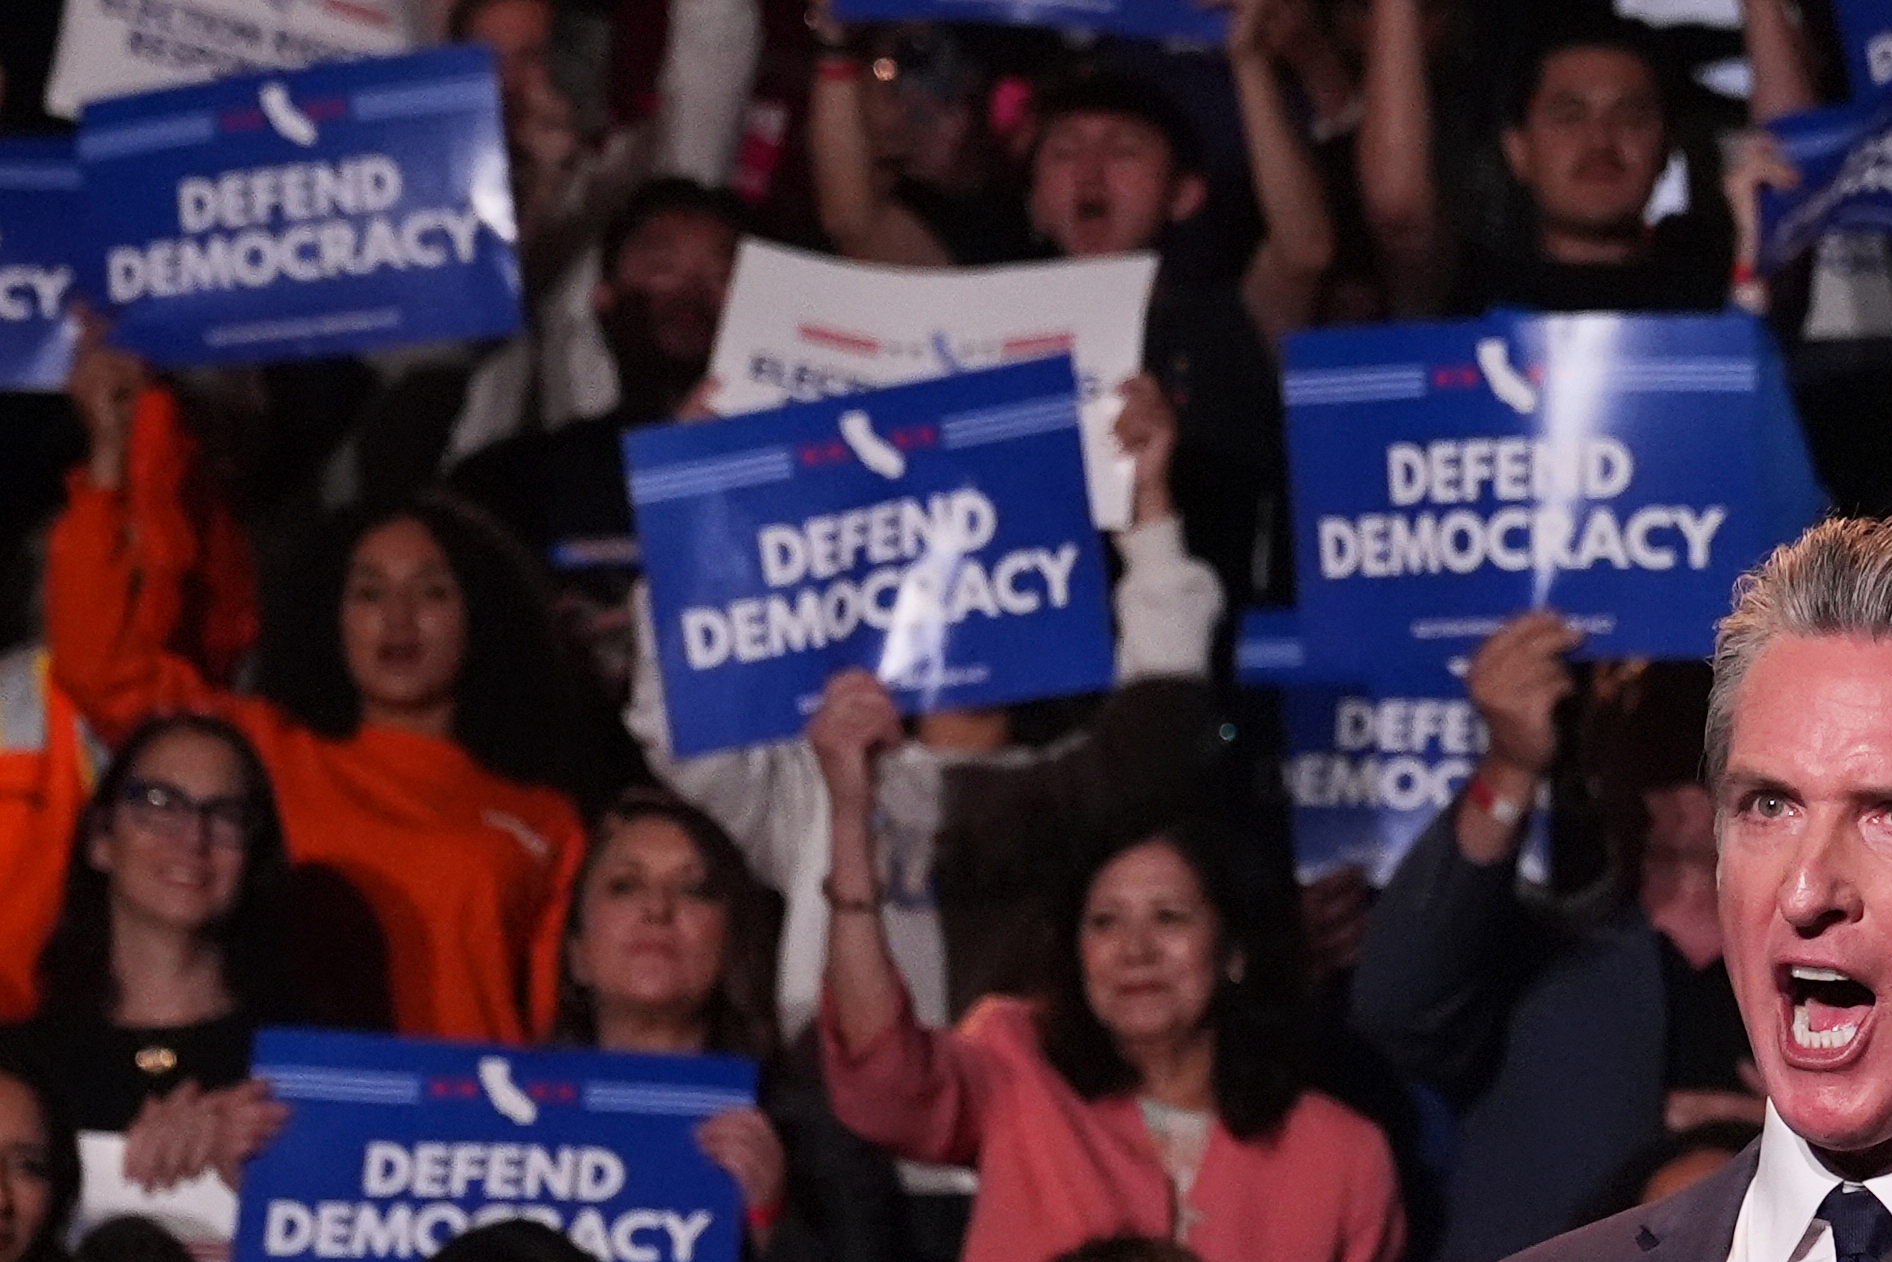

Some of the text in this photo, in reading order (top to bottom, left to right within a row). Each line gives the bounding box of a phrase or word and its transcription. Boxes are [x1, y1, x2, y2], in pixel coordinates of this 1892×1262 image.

[178, 155, 402, 232] DEFEND
[108, 207, 481, 303] DEMOCRACY
[757, 488, 996, 587] DEFEND
[1318, 505, 1726, 579] DEMOCRACY
[1335, 698, 1491, 754] DEFE
[362, 1139, 627, 1202] DEFEND
